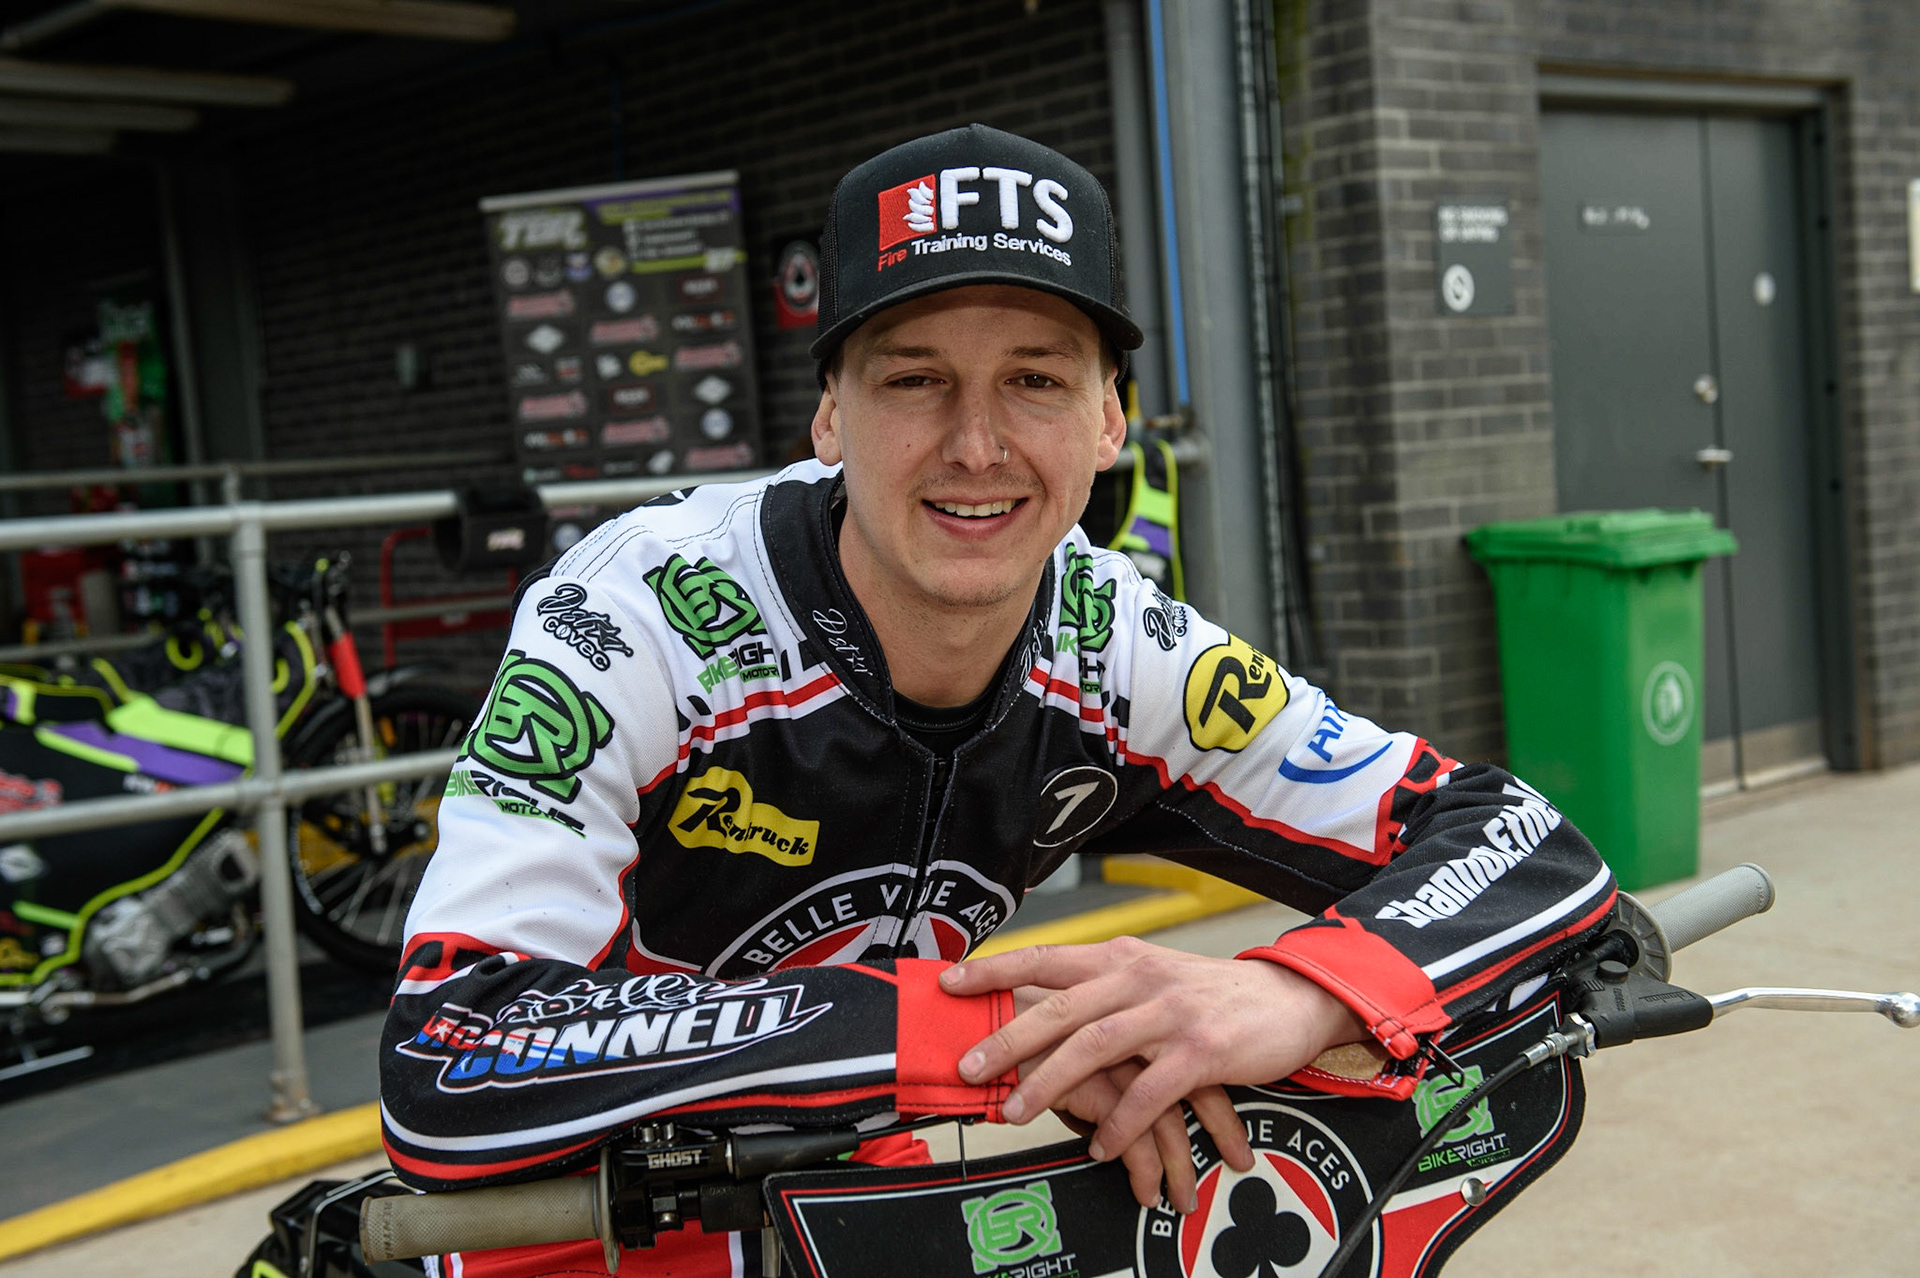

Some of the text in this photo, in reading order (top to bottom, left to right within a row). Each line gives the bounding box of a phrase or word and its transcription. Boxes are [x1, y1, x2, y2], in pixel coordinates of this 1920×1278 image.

[940, 167, 1074, 243] FTS
[877, 232, 1072, 272] Fire Training Services
[743, 667, 780, 681] MOTOR
[1198, 645, 1272, 735] Ren
[743, 892, 858, 965] BELLE
[958, 900, 999, 942] ACES
[647, 1149, 702, 1170] GHOST
[1287, 1128, 1350, 1191] ACES
[1417, 1132, 1507, 1172] BIKERIGHT
